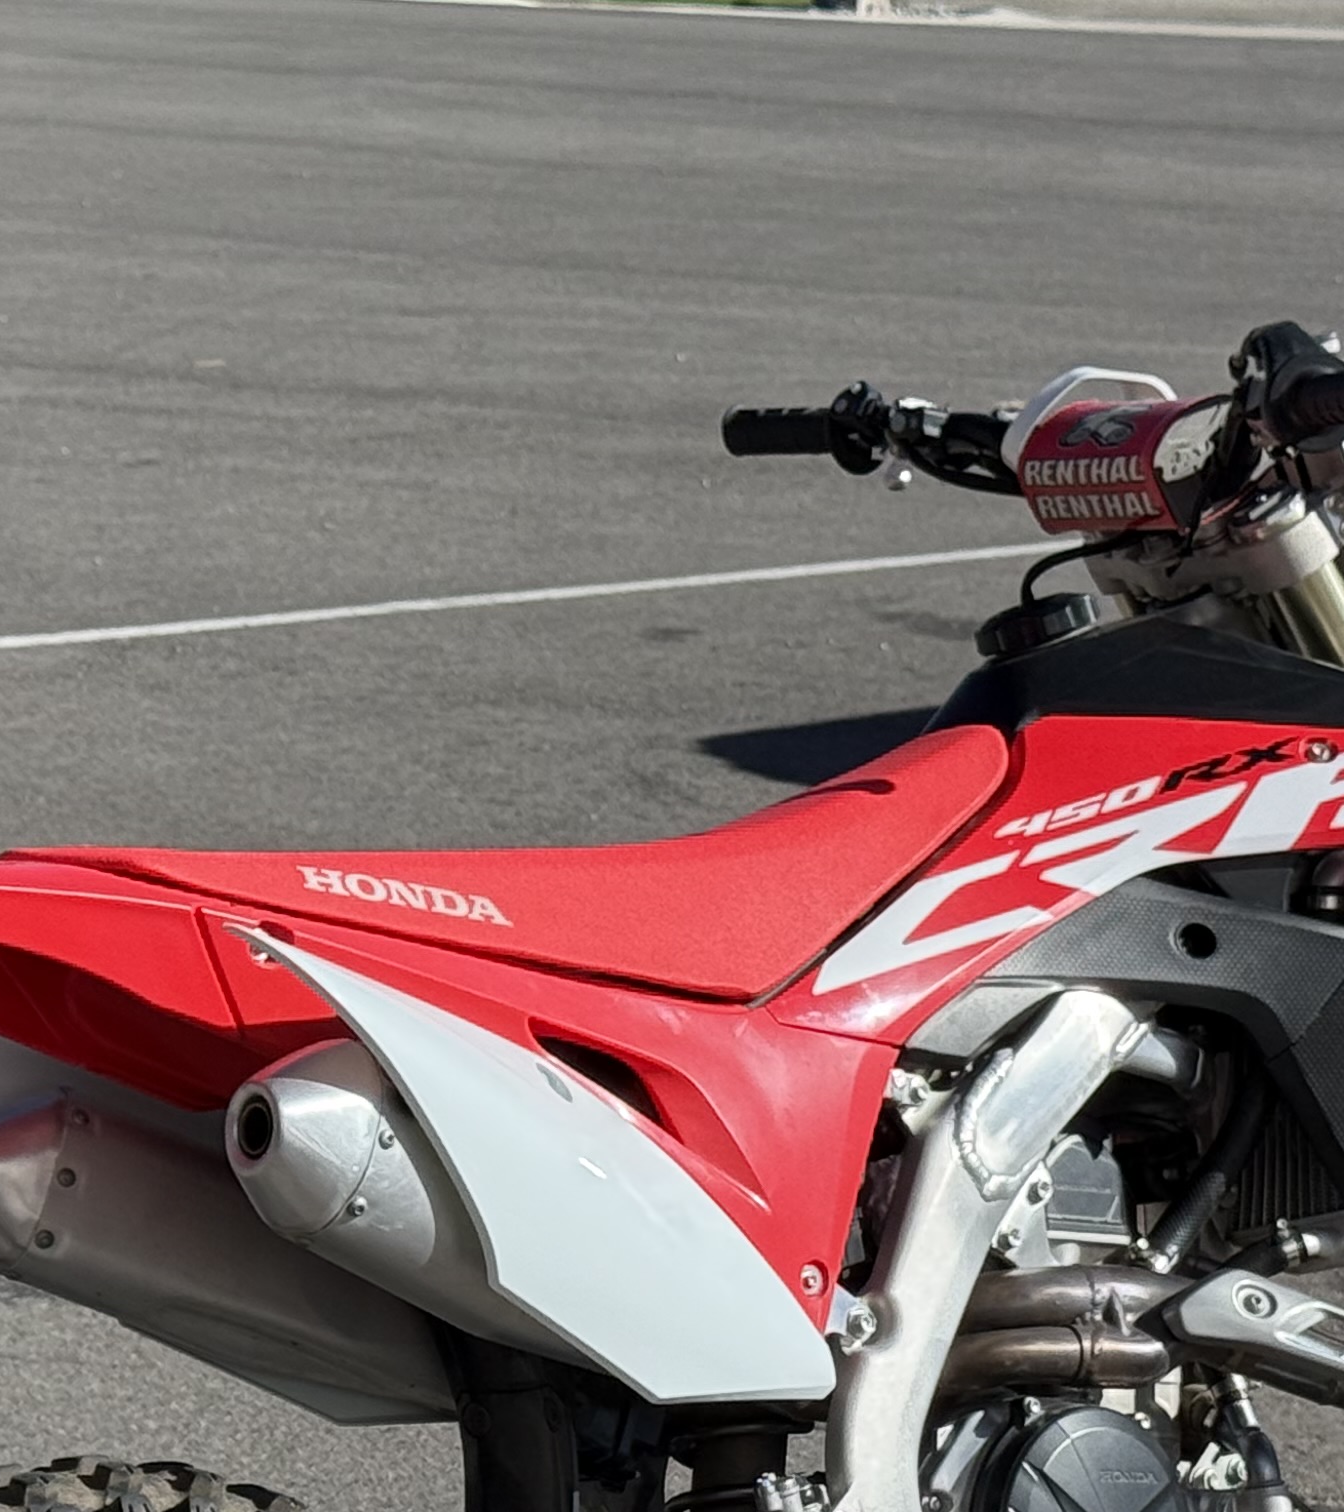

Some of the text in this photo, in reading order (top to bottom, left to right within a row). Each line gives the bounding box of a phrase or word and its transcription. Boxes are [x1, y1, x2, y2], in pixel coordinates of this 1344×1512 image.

[1023, 455, 1145, 486] RENTHAL
[1035, 491, 1161, 519] RENTHAL
[295, 865, 515, 928] HONDA
[1099, 1469, 1159, 1485] HONDA
